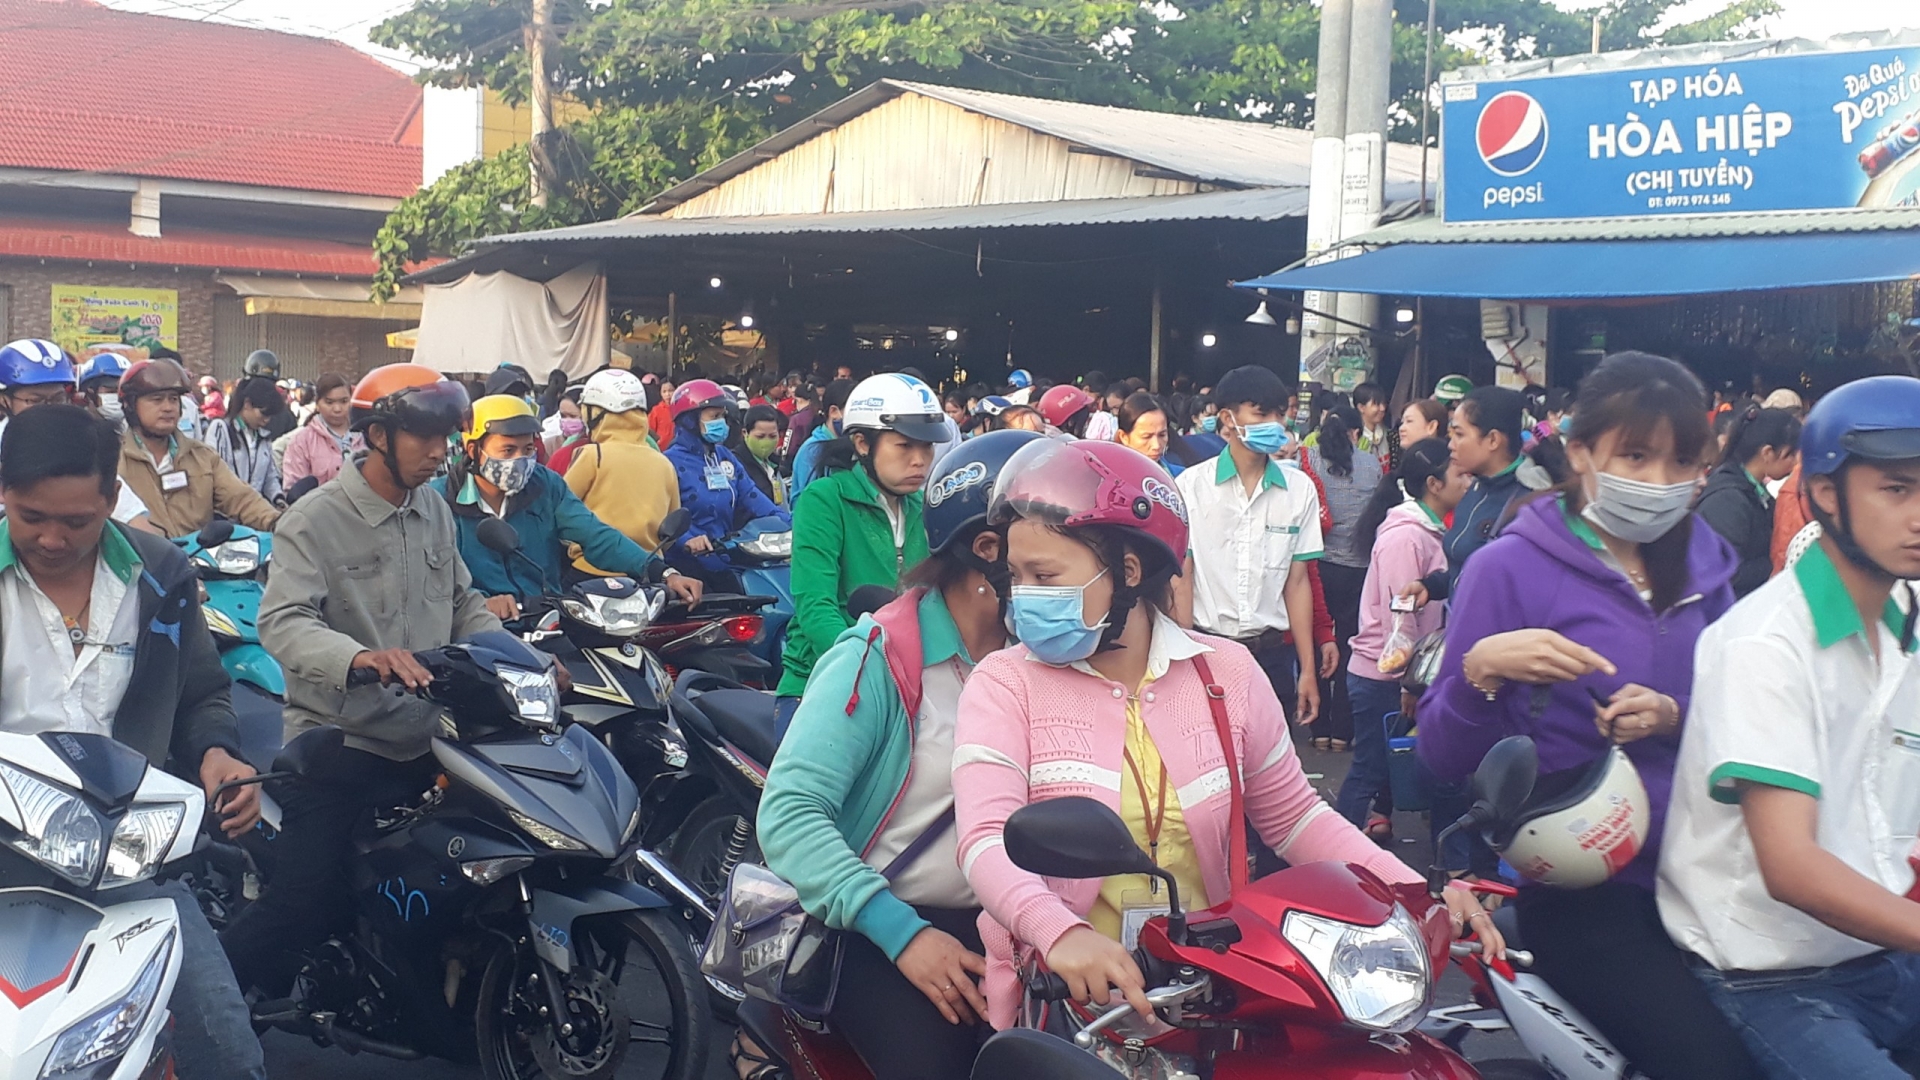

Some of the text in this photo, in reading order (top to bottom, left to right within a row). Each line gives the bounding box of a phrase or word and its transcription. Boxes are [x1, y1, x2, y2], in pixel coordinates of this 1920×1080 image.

[1629, 67, 1744, 109] TẠP HÓA
[1869, 55, 1906, 86] Quá
[1832, 75, 1910, 144] Pepsi
[1588, 102, 1793, 159] HÒA HIỆP
[1483, 181, 1543, 210] pepsi
[1625, 157, 1754, 197] (CHỊ TUYỀN)
[1664, 194, 1690, 207] 0973
[1690, 194, 1711, 206] 974
[1711, 192, 1732, 205] 345
